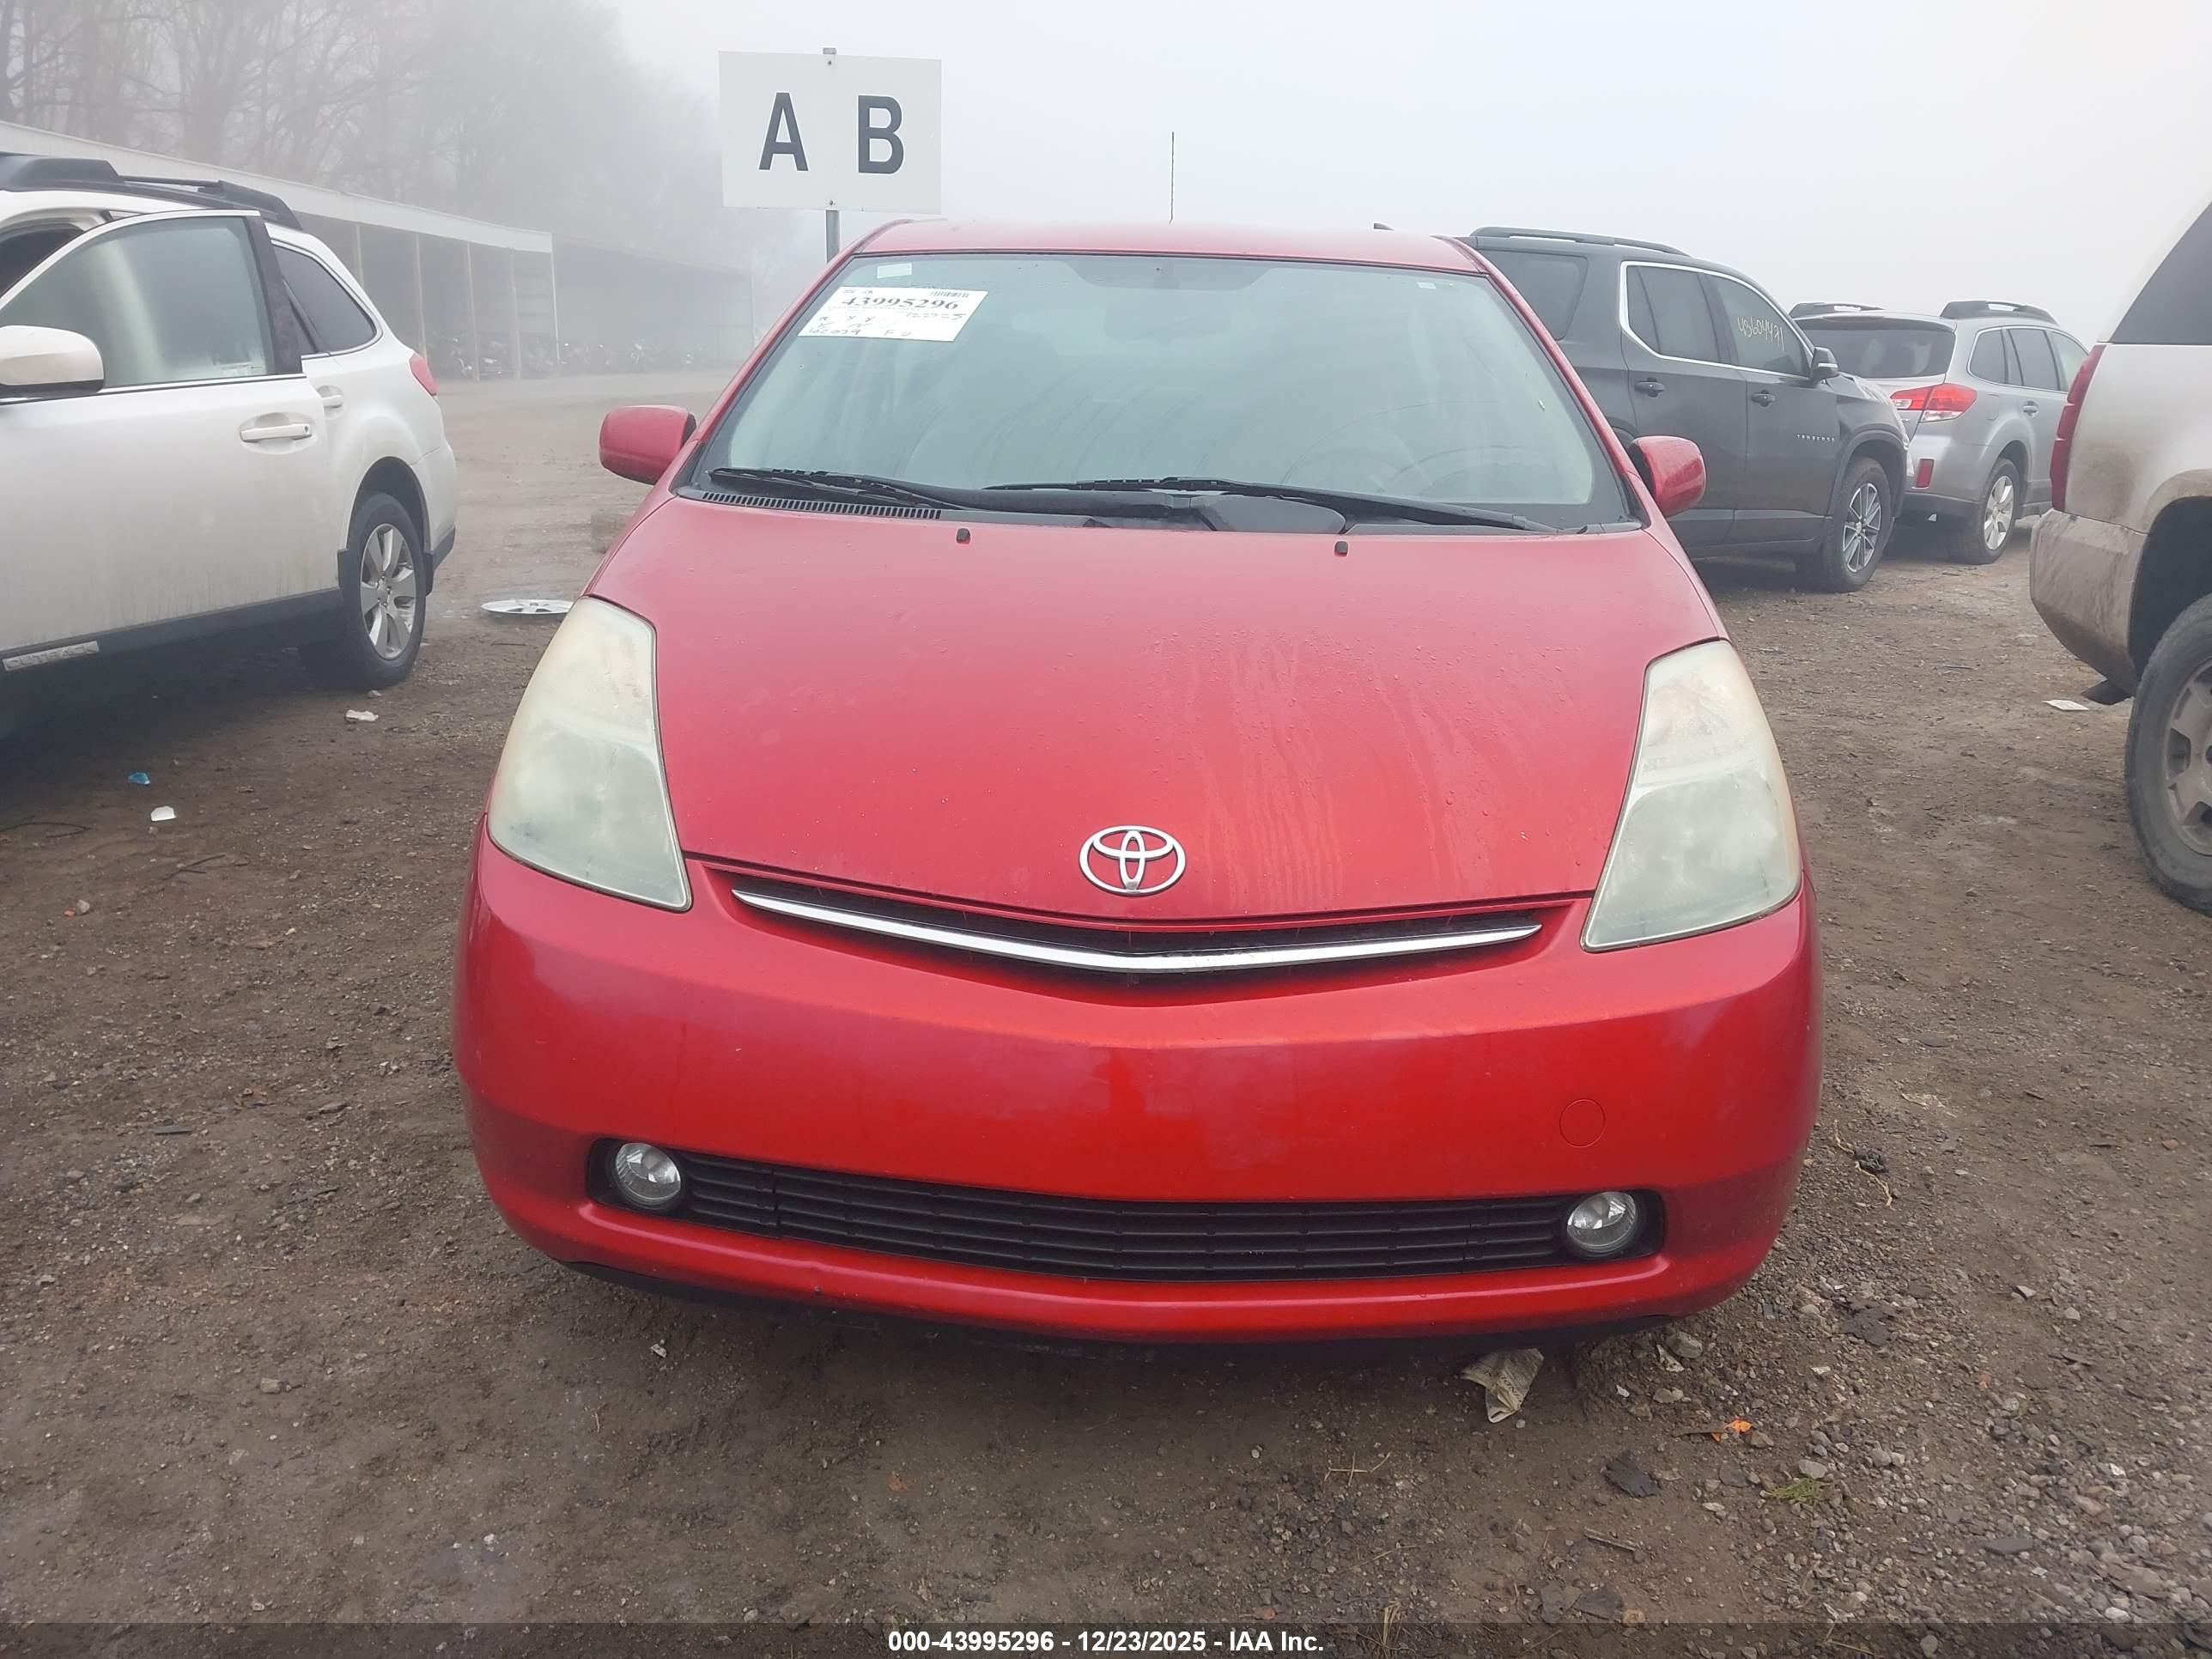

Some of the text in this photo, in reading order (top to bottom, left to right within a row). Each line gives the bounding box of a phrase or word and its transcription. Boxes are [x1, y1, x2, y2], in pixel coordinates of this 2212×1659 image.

[758, 92, 904, 174] A B
[841, 297, 959, 309] 43995296
